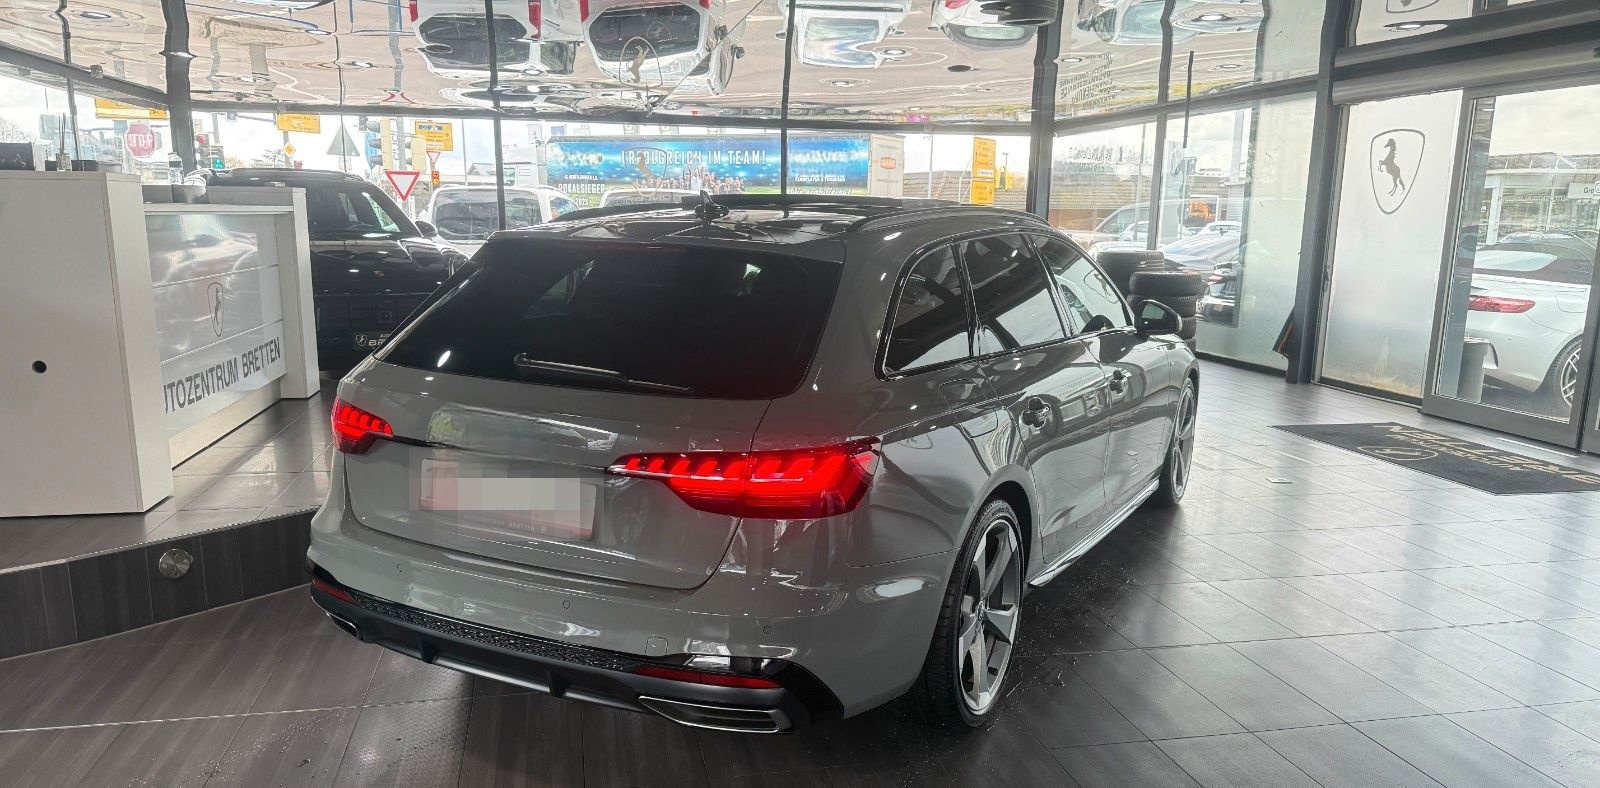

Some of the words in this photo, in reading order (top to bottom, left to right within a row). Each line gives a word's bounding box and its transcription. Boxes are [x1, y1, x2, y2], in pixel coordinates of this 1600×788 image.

[727, 150, 767, 165] TEAM!
[163, 357, 239, 414] TOZENTRUM
[241, 337, 281, 379] BRETTEN
[508, 522, 536, 532] BRETTEN
